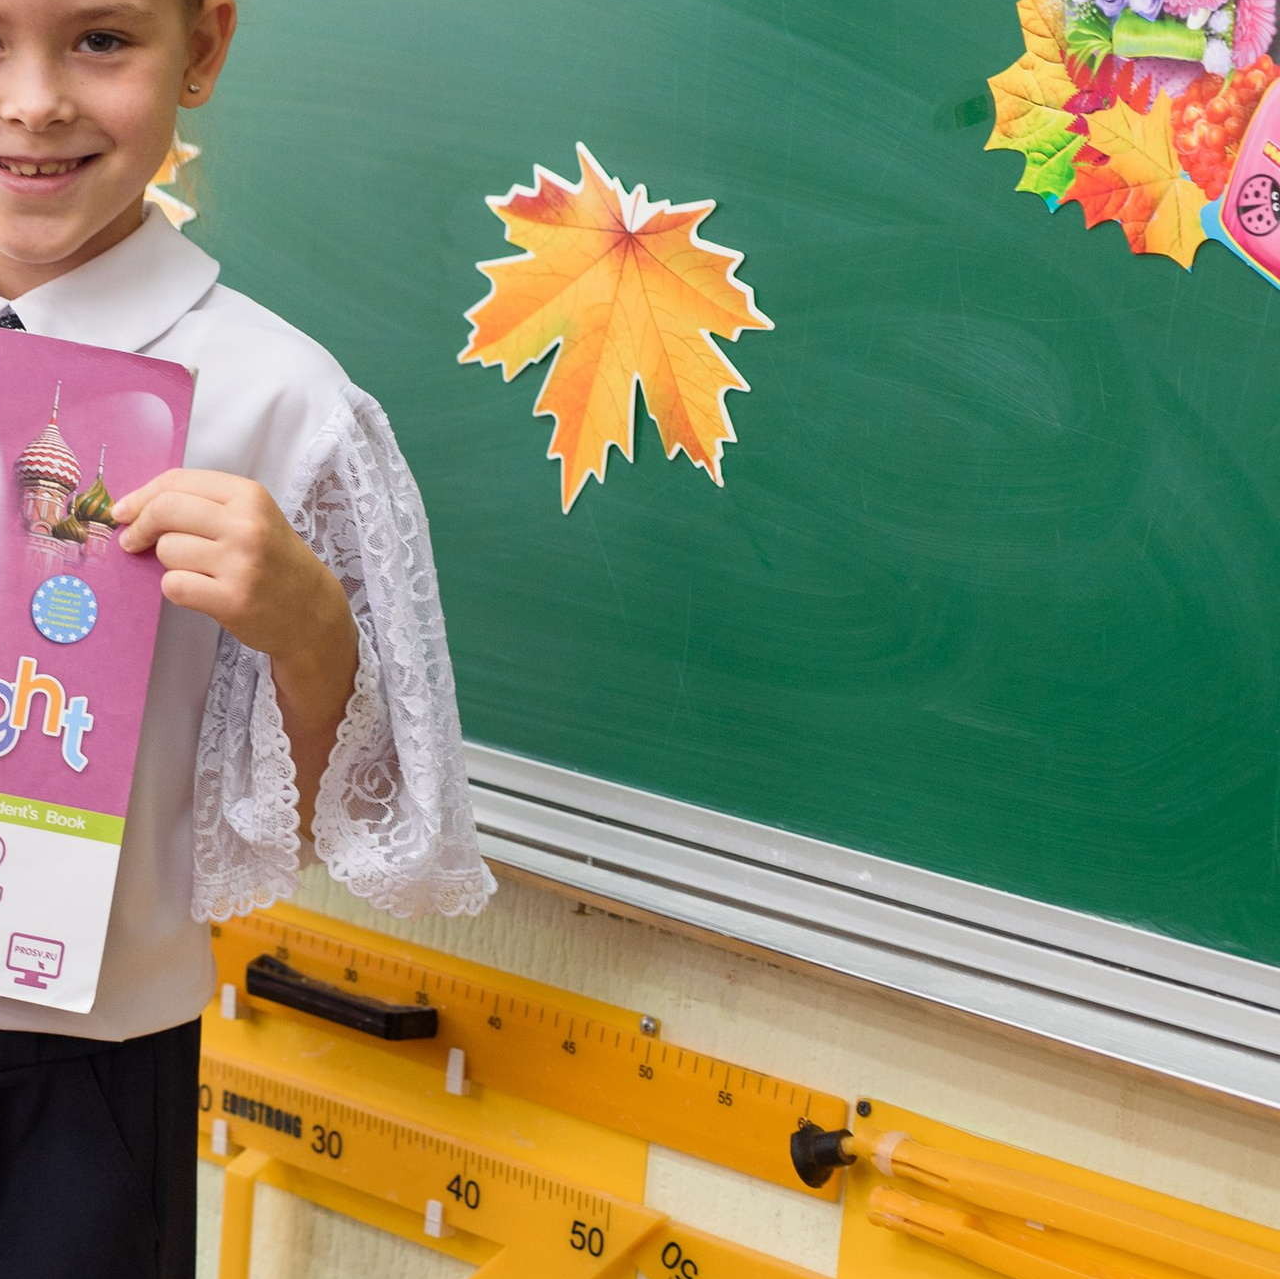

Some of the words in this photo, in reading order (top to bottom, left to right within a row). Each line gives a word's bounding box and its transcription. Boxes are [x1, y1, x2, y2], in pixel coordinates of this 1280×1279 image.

[45, 809, 86, 830] Book
[14, 945, 58, 961] PROSV.RU
[487, 1016, 502, 1031] 40
[562, 1040, 577, 1055] 45
[639, 1065, 654, 1080] 50
[717, 1090, 733, 1107] 55
[311, 1124, 343, 1160] 30
[446, 1174, 480, 1210] 40
[570, 1220, 605, 1258] 50
